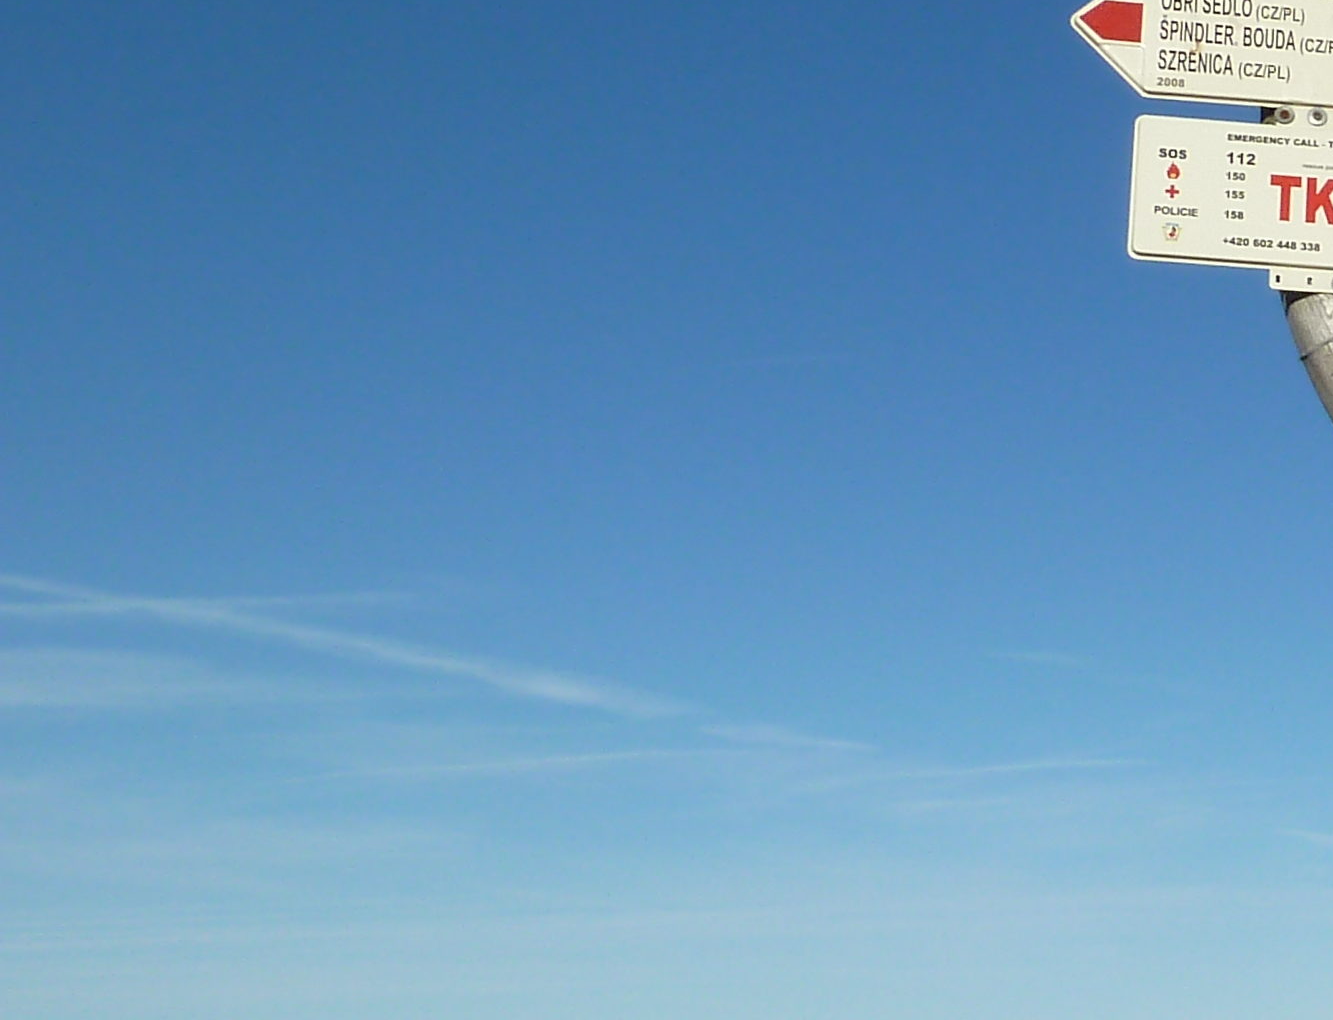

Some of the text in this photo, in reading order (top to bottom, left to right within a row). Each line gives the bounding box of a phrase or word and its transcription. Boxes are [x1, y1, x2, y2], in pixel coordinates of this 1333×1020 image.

[1256, 4, 1305, 25] (CZ/PL)
[1243, 27, 1296, 51] BOUDA
[1158, 49, 1233, 76] SZRENICA
[1239, 62, 1290, 84] (CZ/PL)
[1157, 77, 1185, 88] 2008
[1227, 134, 1290, 145] EMERGENCY
[1294, 139, 1319, 147] CALL
[1159, 148, 1255, 165] SOS 112
[1226, 172, 1245, 180] 150
[1225, 190, 1244, 199] 155
[1154, 206, 1198, 217] POLICIE
[1224, 210, 1244, 219] 158
[1223, 237, 1320, 251] +420 602 448 338
